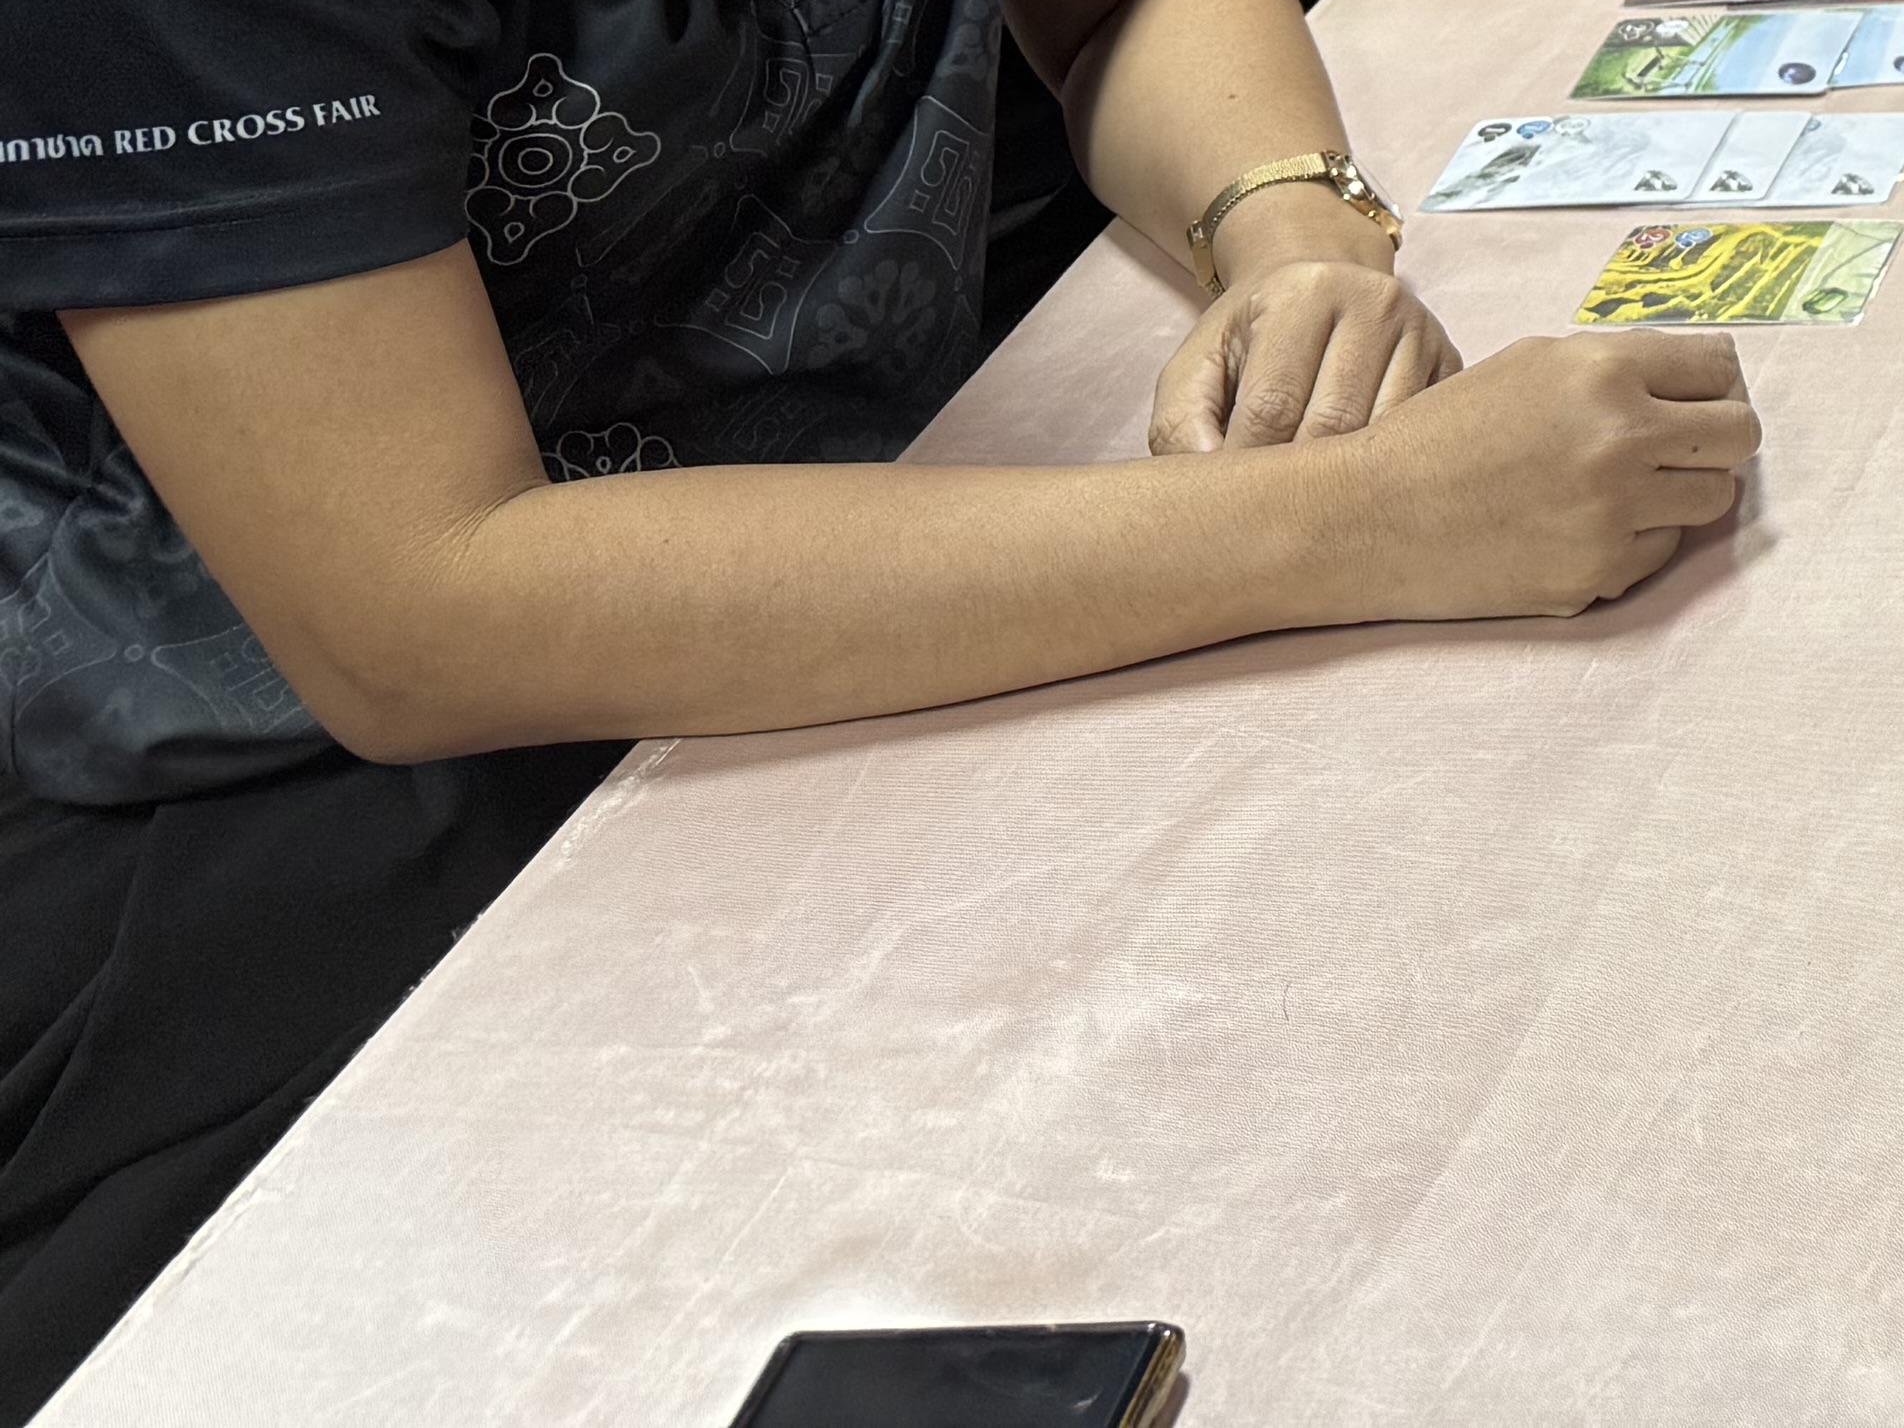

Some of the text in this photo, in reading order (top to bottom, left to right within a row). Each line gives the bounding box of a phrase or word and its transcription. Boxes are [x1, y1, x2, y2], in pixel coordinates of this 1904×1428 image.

[113, 125, 177, 155] RED
[187, 106, 306, 146] CROSS
[312, 93, 382, 128] FAIR
